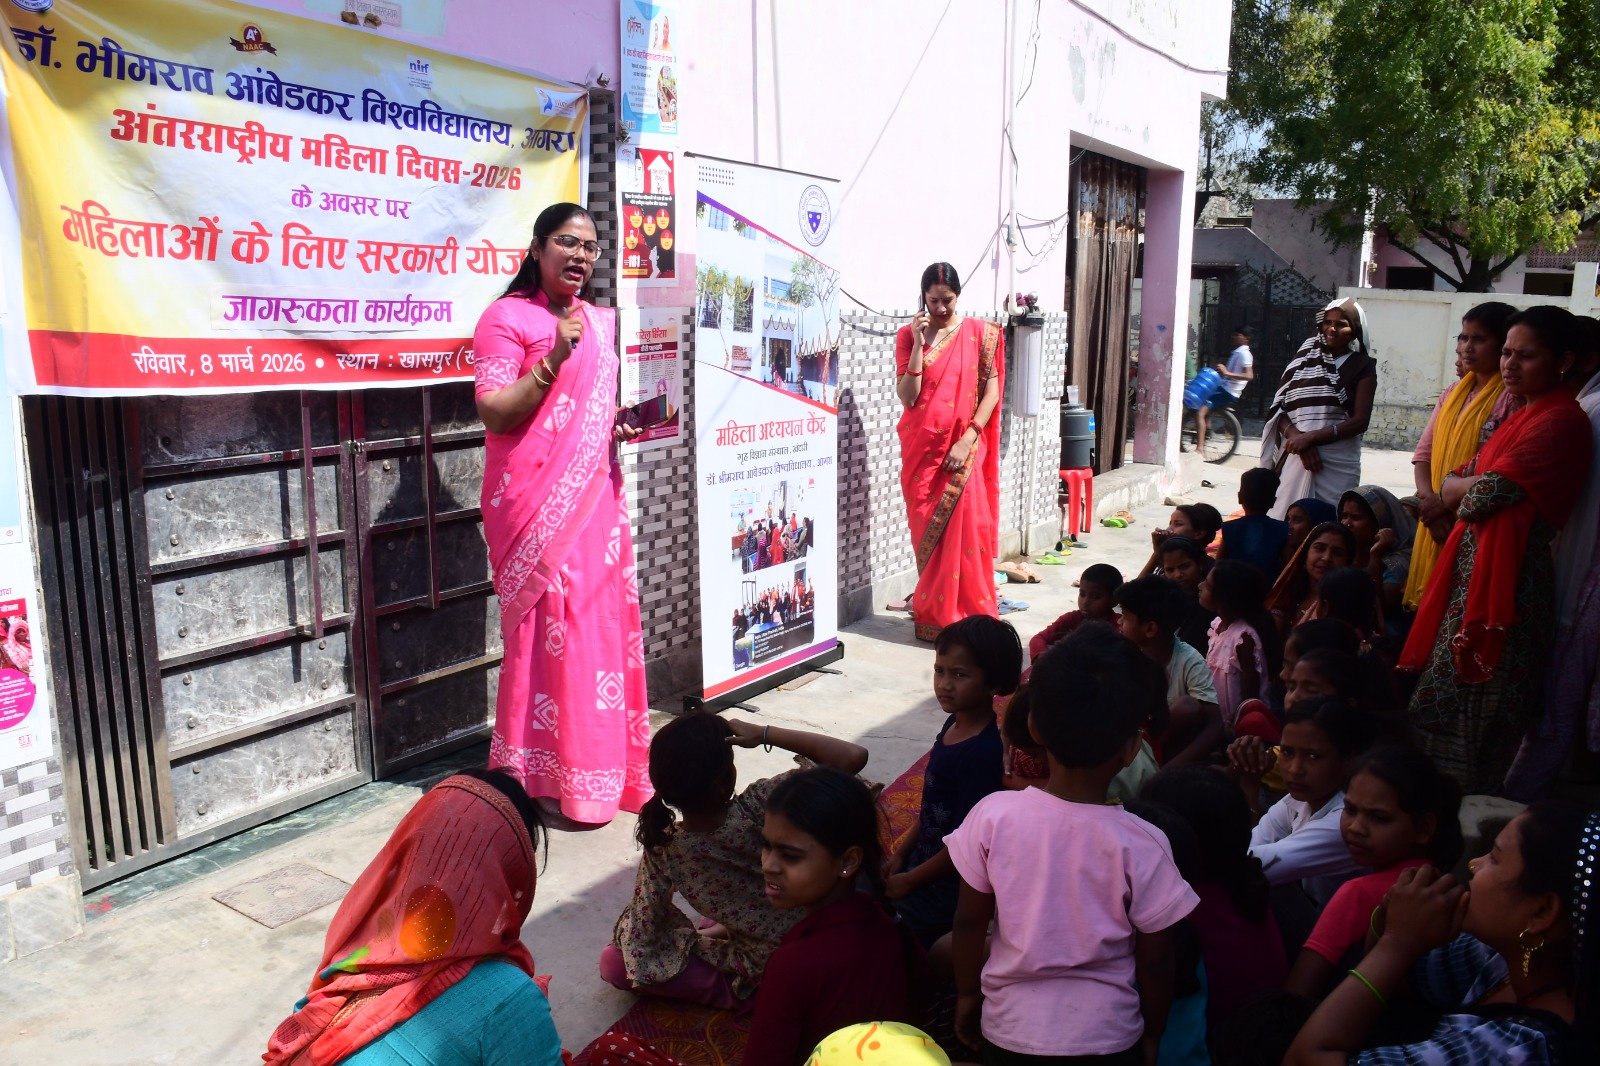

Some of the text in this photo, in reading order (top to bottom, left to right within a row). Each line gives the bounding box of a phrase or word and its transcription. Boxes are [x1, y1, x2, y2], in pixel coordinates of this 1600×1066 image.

[242, 43, 264, 51] NAAC
[410, 60, 429, 73] nirf
[10, 25, 576, 153] डॉ. भीमराव आंबेडकर विश्वविद्यालय, आगरा
[110, 102, 522, 191] अंतरराष्ट्रीय महिला दिवस-2026
[291, 184, 412, 219] के अवसर पर
[61, 200, 530, 276] महिलाओं के लिए सरकारी योज
[222, 294, 453, 326] जागरूकता कार्यक्रम
[651, 327, 668, 339] हिंसा
[132, 345, 194, 376] रविवार,
[200, 353, 213, 374] 8
[218, 346, 254, 373] मार्च
[260, 353, 305, 373] 2026
[336, 351, 379, 370] स्थान
[398, 350, 454, 374] खासपुर
[715, 411, 827, 447] महिला अध्ययन केंद्र
[737, 452, 749, 465] गृह
